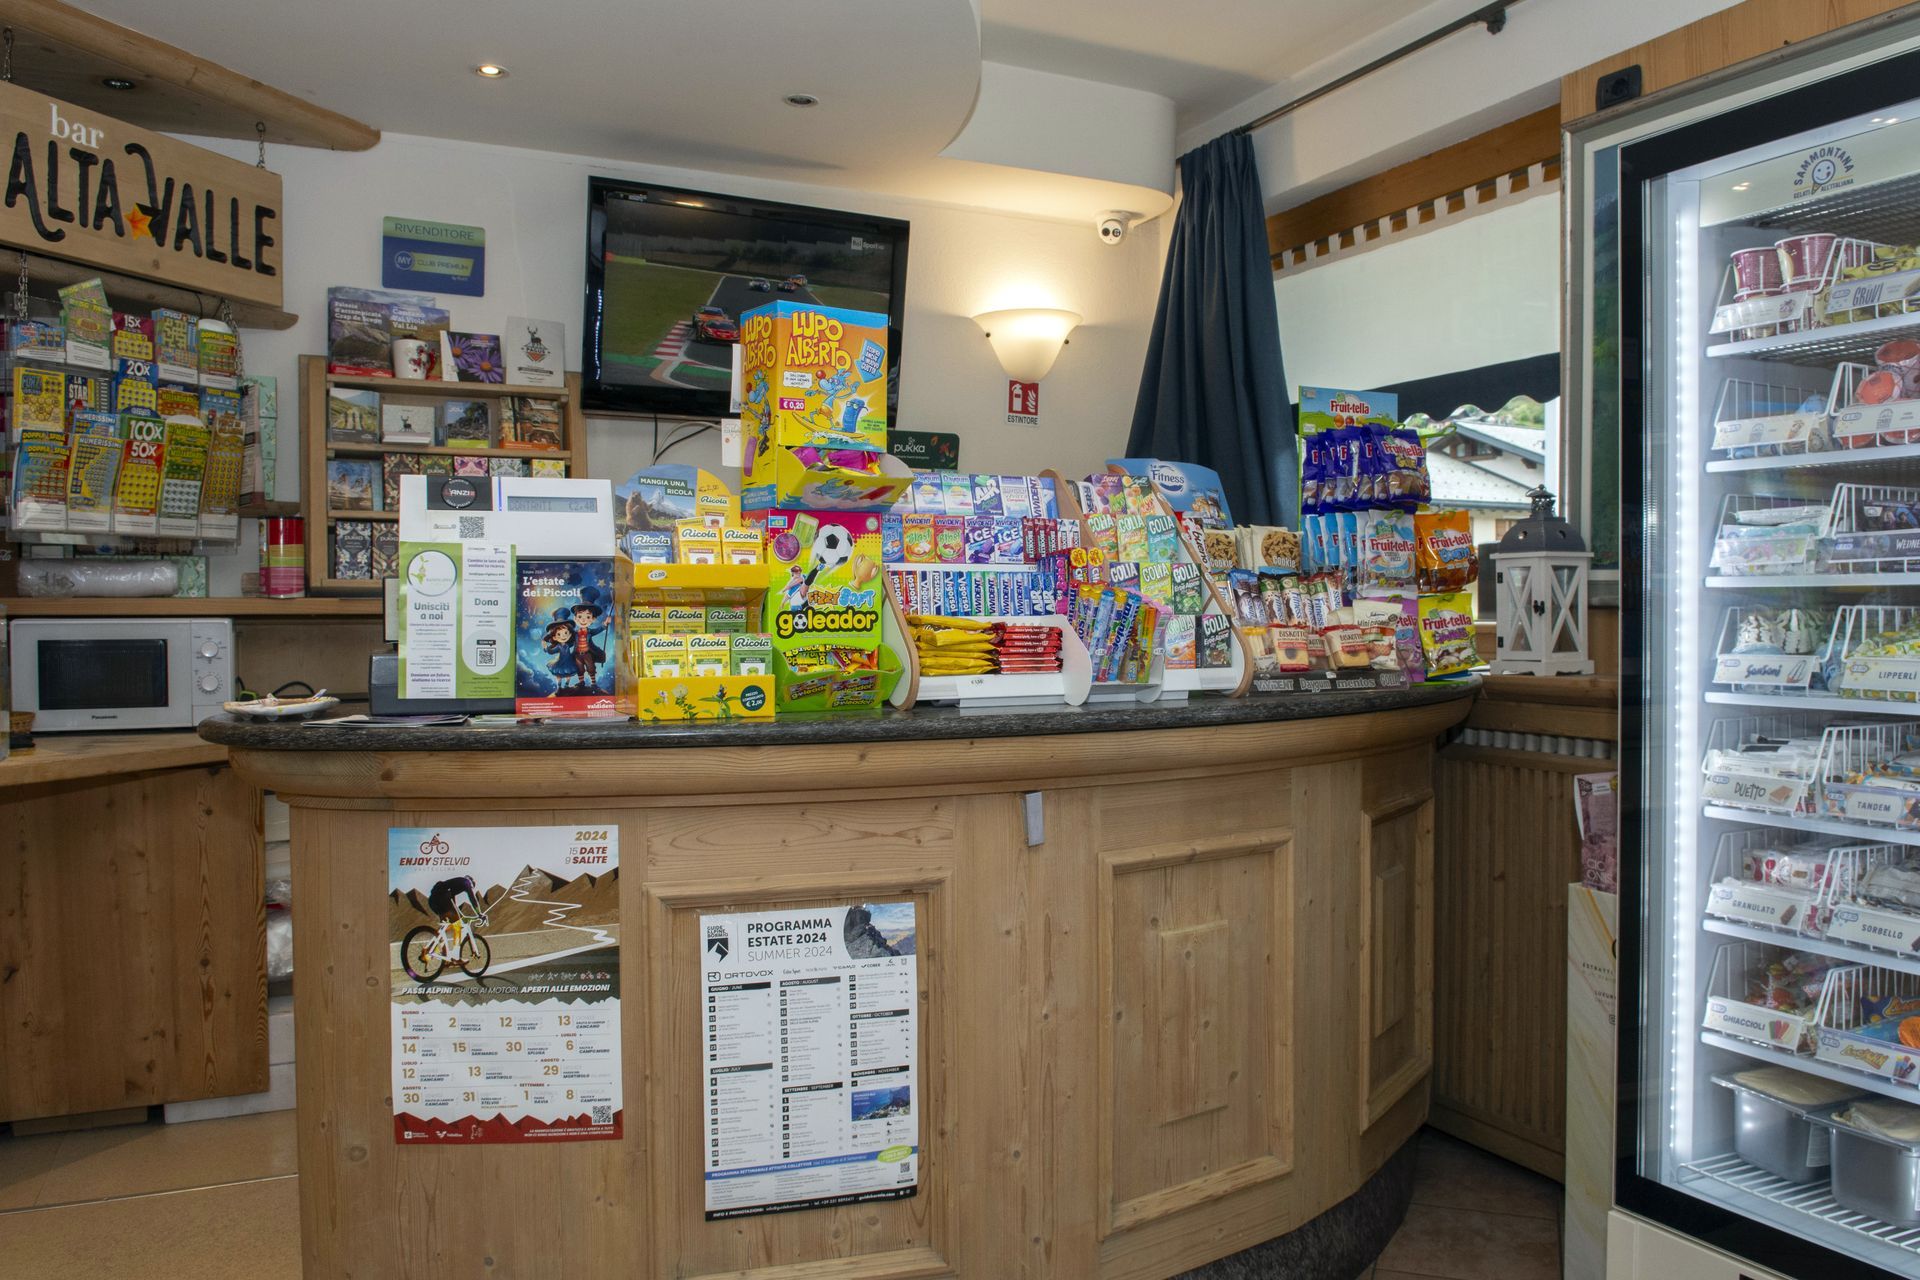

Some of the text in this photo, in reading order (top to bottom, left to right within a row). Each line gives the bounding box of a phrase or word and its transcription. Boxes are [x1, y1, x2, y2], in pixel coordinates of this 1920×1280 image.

[50, 103, 104, 149] bar
[1794, 146, 1855, 187] SAMMONTANA
[5, 131, 277, 276] ALTA VALLE
[394, 222, 475, 241] RIVENDITORE
[745, 314, 773, 342] LUPO
[792, 311, 844, 341] LUPO
[786, 336, 851, 371] ALBERTO
[783, 401, 805, 411] € 0,20
[1330, 399, 1370, 414] Fruit-tella
[1007, 415, 1038, 425] ESTINTORE
[894, 442, 926, 454] pukka
[640, 477, 686, 487] MANGIA UNA
[1151, 471, 1185, 484] Fitness
[667, 488, 693, 496] RICOLA
[1030, 476, 1041, 518] VIVIDENT
[701, 495, 728, 505] Ricola
[681, 528, 717, 539] Ricola
[724, 530, 759, 540] Ricola
[969, 527, 993, 543] ICE
[997, 527, 1020, 543] ICE
[633, 535, 670, 545] Ricola
[1371, 539, 1415, 552] Fruit-tella
[523, 576, 565, 587] L'estate
[523, 587, 581, 597] dei Piccoli
[974, 578, 983, 614] VIVIDENT
[1002, 580, 1010, 614] VIVIDENT
[1016, 579, 1024, 614] VIVIDENT
[414, 601, 450, 611] Unisciti
[474, 598, 499, 606] Dona
[428, 611, 444, 620] noi
[629, 609, 661, 619] Ricola
[668, 609, 702, 619] Ricola
[710, 609, 744, 620] Ricola
[778, 609, 877, 637] goleador
[1423, 615, 1472, 631] Fruit-tella
[646, 637, 683, 647] Ricola
[690, 637, 727, 647] Ricola
[734, 637, 770, 647] Ricola
[1299, 678, 1331, 693] Daygum
[1337, 677, 1376, 688] mentos
[1734, 782, 1766, 800] DUETTO
[1857, 801, 1891, 812] TANDEM
[574, 831, 608, 841] 2024
[569, 846, 608, 855] 15 DATE
[399, 856, 470, 866] ENJOY STELVIO
[572, 855, 608, 865] SALITE
[1732, 899, 1775, 915] GRANULATO
[747, 918, 832, 934] PROGRAMMA
[1862, 923, 1903, 940] SORBELLO
[747, 932, 826, 948] ESTATE 2024
[748, 946, 833, 962] SUMMER 2024
[724, 969, 774, 980] ORTOVOX
[401, 987, 425, 995] PASSI
[426, 987, 453, 995] ALPINI
[520, 985, 549, 993] APERTI
[550, 985, 569, 993] ALLE
[569, 984, 610, 993] EMOZIONI
[402, 1018, 407, 1028] 1
[449, 1017, 456, 1028] 2
[499, 1016, 513, 1028] 12
[558, 1015, 571, 1026] 13
[402, 1043, 417, 1054] 14
[452, 1042, 467, 1052] 15
[505, 1041, 522, 1052] 30
[566, 1040, 574, 1051] 6
[402, 1068, 415, 1079] 12
[468, 1066, 481, 1077] 13
[543, 1065, 559, 1075] 29
[403, 1093, 420, 1104] 30
[463, 1091, 476, 1102] 31
[524, 1090, 529, 1100] 1
[566, 1089, 574, 1100] 8
